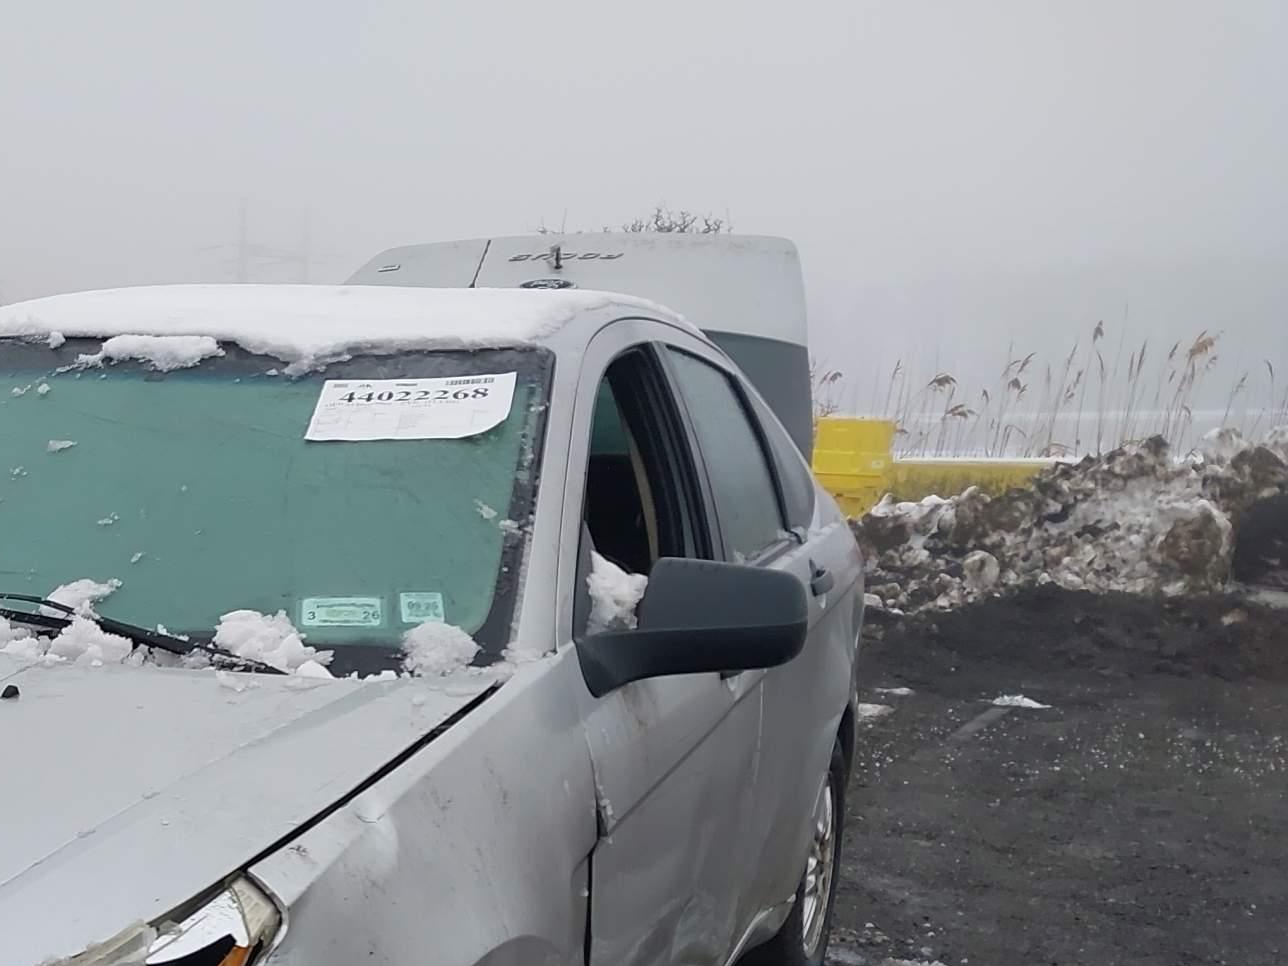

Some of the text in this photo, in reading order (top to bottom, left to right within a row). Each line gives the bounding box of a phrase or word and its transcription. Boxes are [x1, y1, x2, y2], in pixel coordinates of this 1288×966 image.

[339, 387, 489, 403] 44022268
[307, 611, 316, 621] 3
[362, 610, 380, 620] 26
